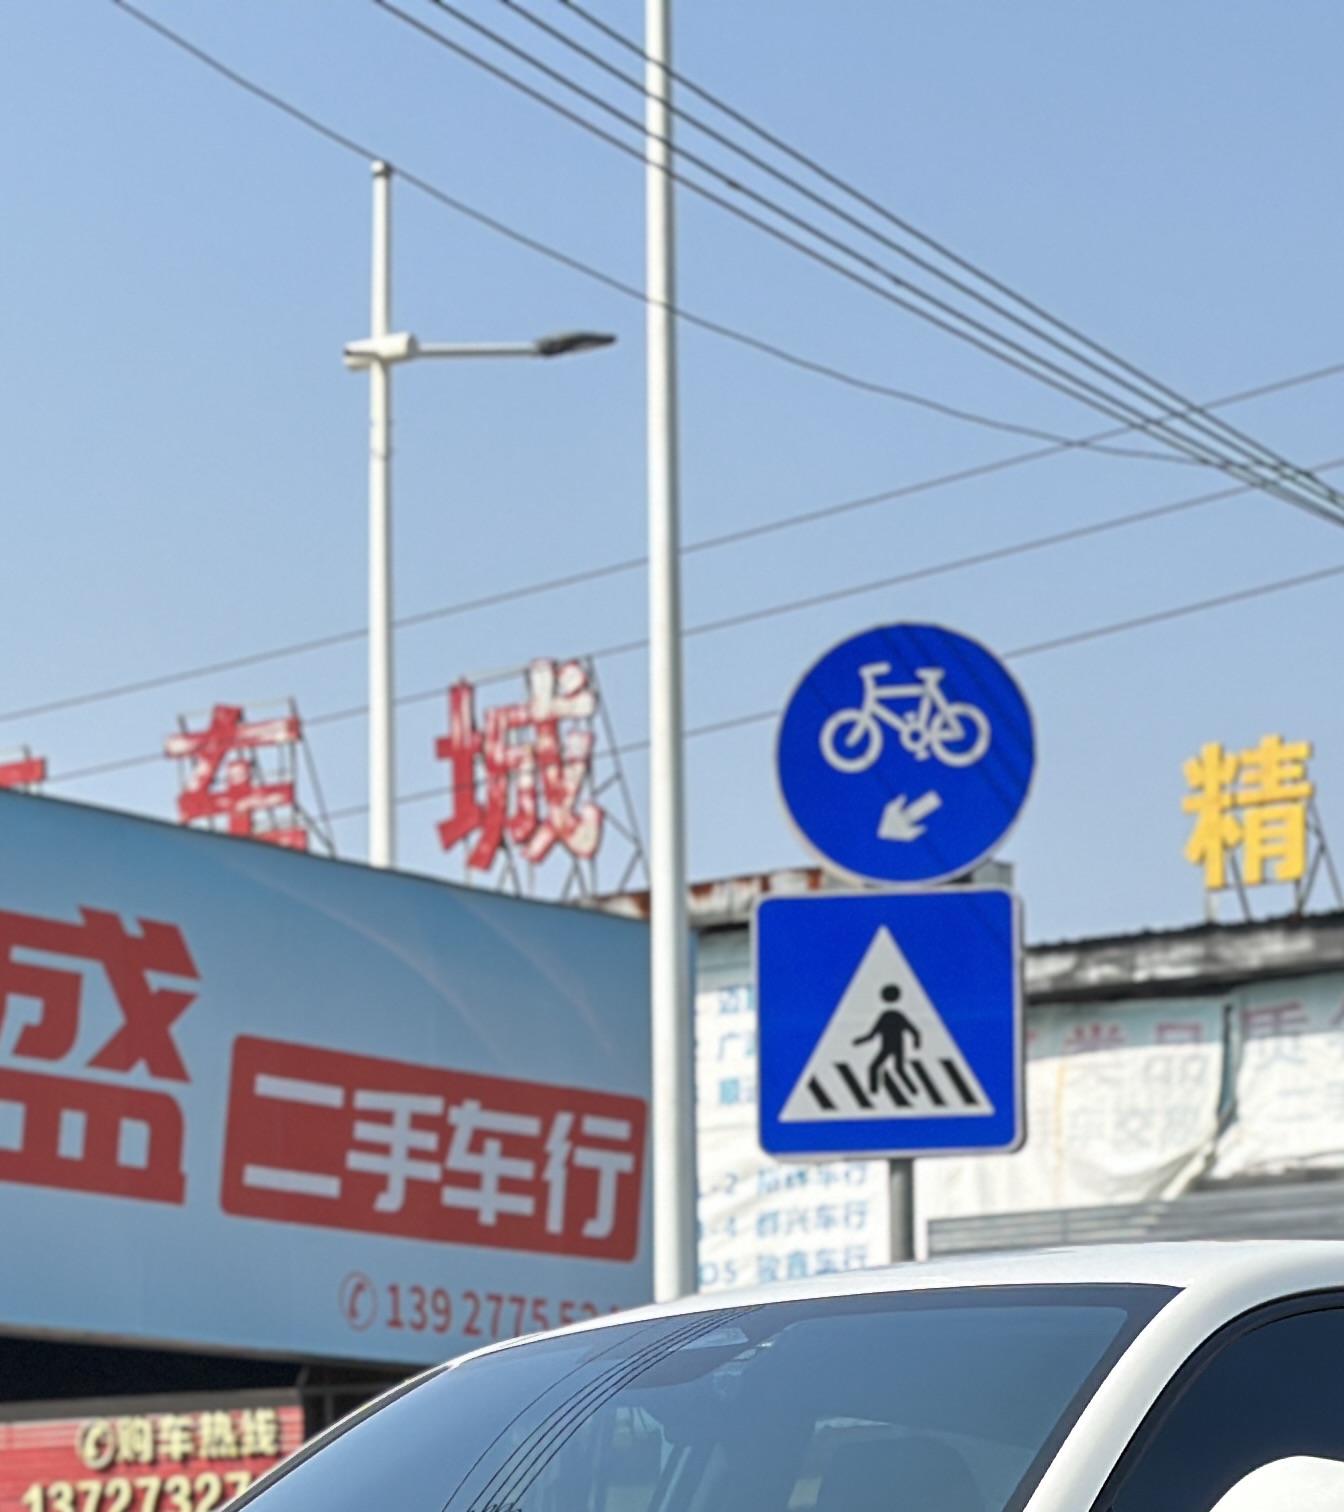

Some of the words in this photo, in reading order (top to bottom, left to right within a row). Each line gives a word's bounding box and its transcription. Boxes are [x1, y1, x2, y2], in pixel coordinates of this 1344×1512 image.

[244, 1073, 634, 1238] 二手车行
[386, 1283, 452, 1333] 139
[462, 1290, 551, 1338] 2775
[117, 1408, 278, 1463] 购车热线
